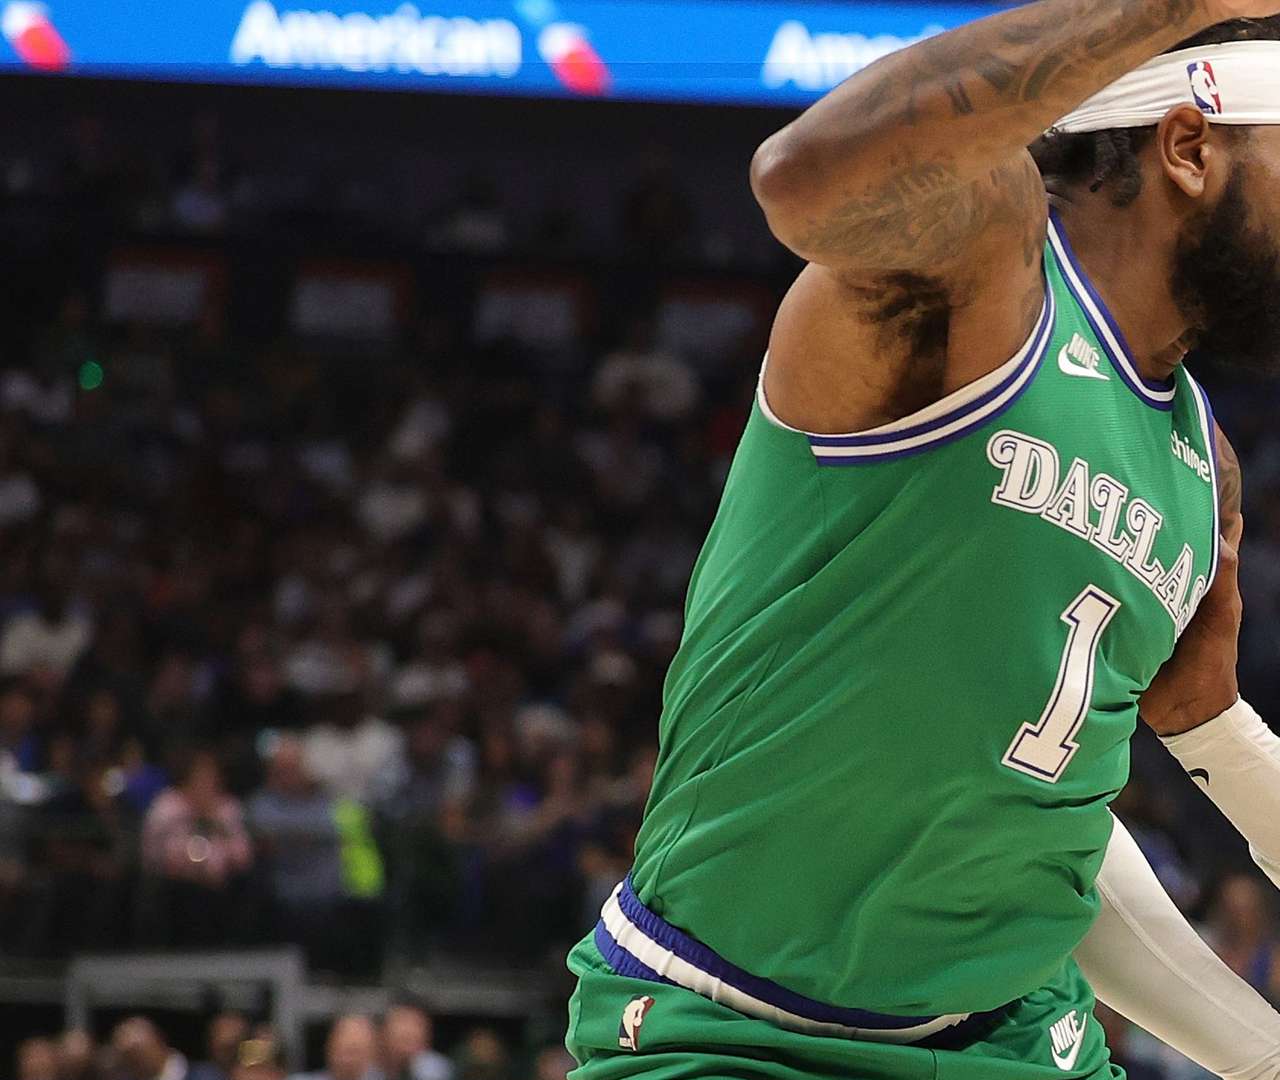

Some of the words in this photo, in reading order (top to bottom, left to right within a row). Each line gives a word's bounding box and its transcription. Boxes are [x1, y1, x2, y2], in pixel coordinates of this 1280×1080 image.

[230, 0, 514, 77] American
[1001, 583, 1122, 783] 1
[1049, 1009, 1079, 1055] NIKE
